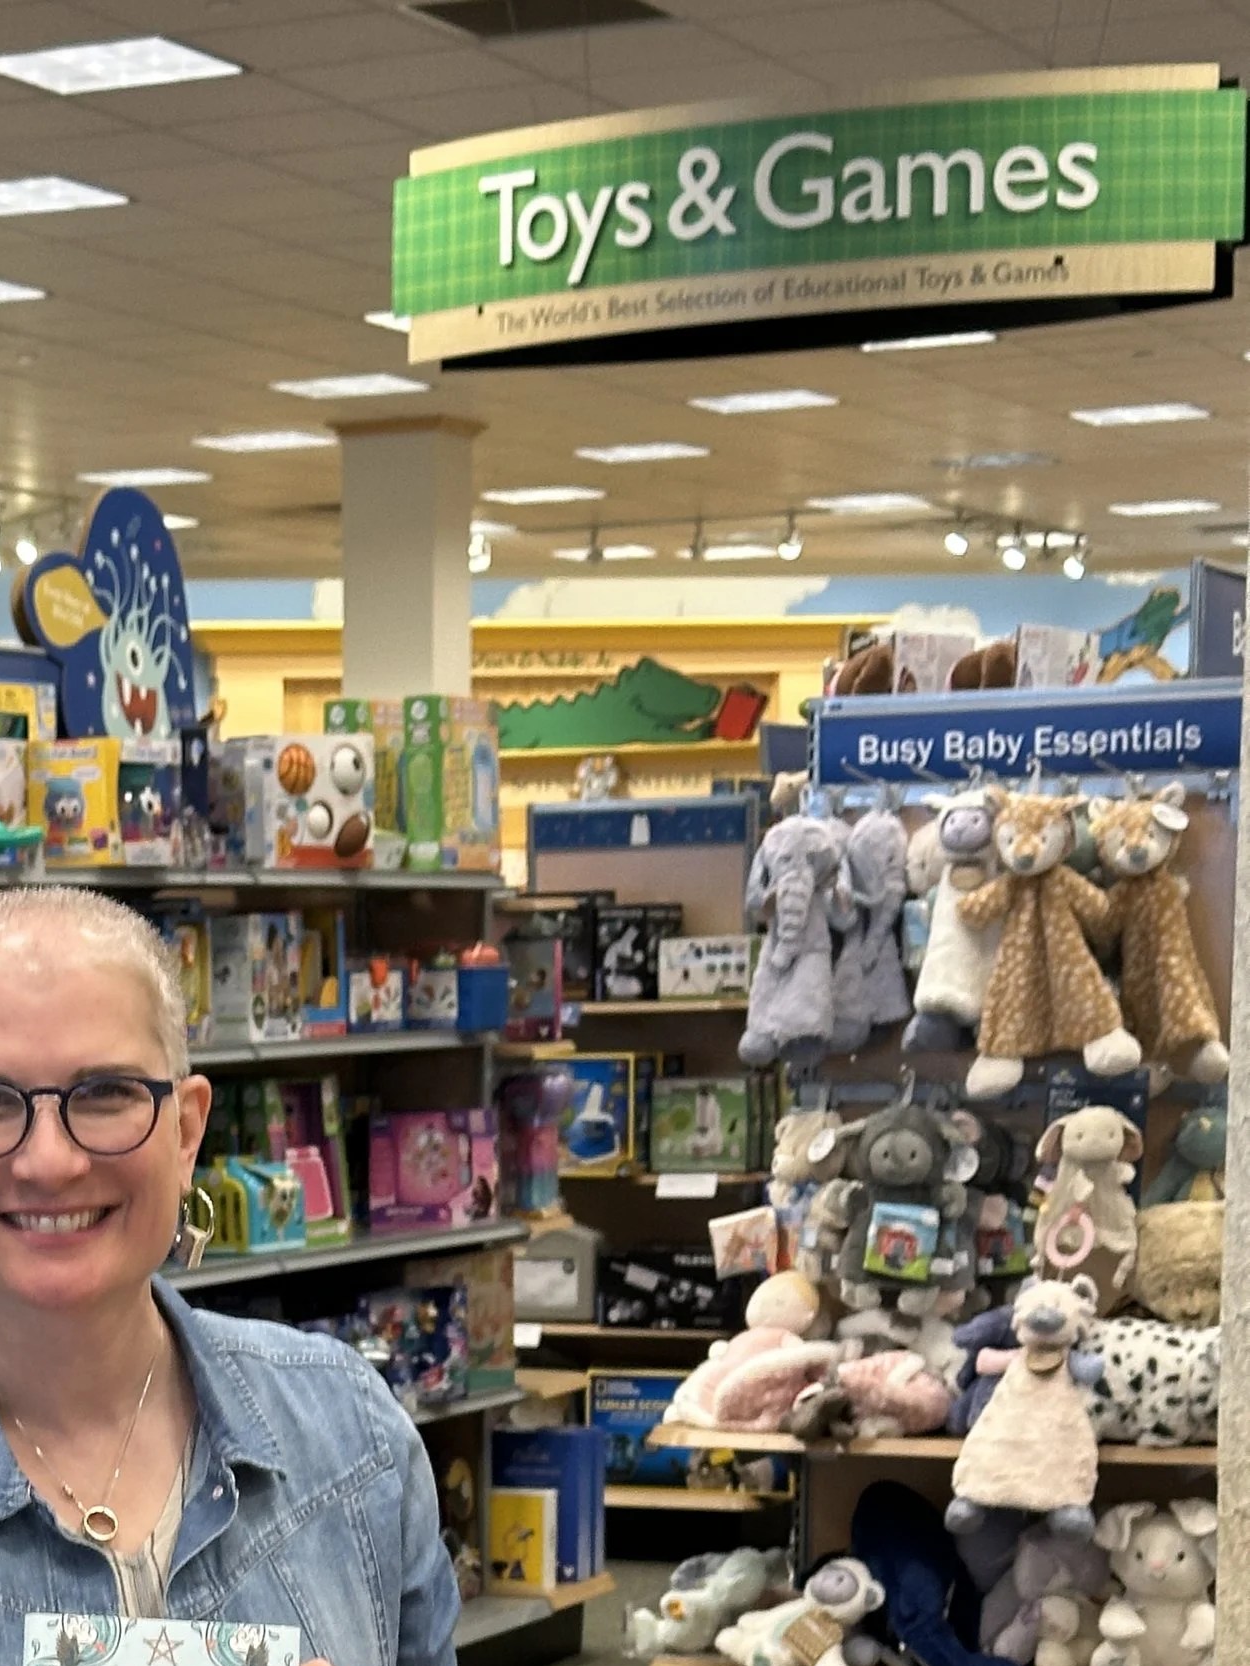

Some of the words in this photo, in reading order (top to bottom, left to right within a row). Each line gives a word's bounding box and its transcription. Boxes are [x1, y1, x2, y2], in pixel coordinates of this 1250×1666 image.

[478, 168, 652, 287] Toys
[667, 145, 738, 242] &
[753, 131, 1101, 231] Games
[498, 310, 527, 333] The
[531, 302, 600, 329] World's
[607, 295, 648, 320] Best
[655, 285, 747, 314] Selection
[753, 280, 774, 304] of
[783, 269, 907, 301] Educational
[917, 266, 964, 295] Toys
[970, 264, 987, 286] &
[993, 258, 1070, 284] Games
[857, 732, 936, 768] Busy
[942, 728, 1024, 766] Baby
[1033, 719, 1203, 758] Essentials
